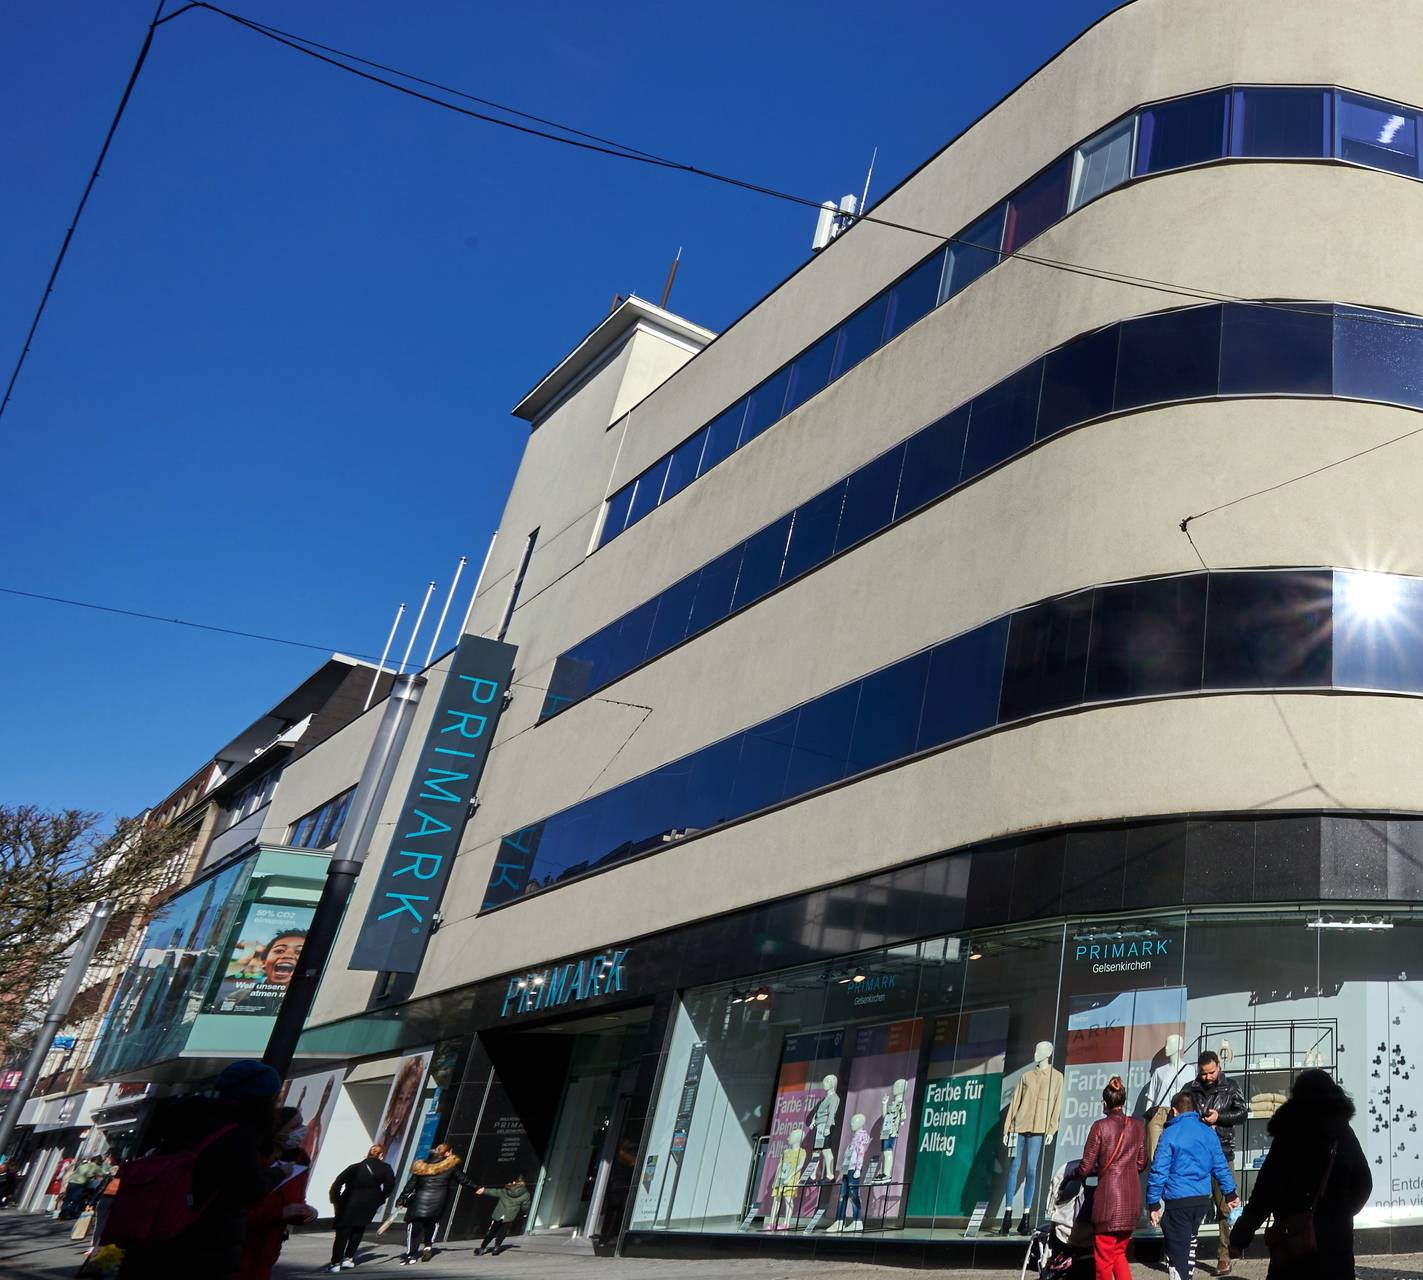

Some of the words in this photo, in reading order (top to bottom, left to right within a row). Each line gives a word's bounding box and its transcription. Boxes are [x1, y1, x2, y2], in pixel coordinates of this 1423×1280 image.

[377, 674, 499, 923] PRIMARK
[1076, 940, 1168, 960] PRIMARK
[1092, 961, 1151, 973] Gelsenkirchen
[501, 948, 631, 1017] PRIMARK
[927, 1082, 961, 1103] Farbe
[964, 1080, 984, 1100] für
[776, 1096, 802, 1114] Farbe
[804, 1094, 821, 1111] für
[923, 1107, 967, 1128] Deinen
[919, 1132, 956, 1156] Alltag
